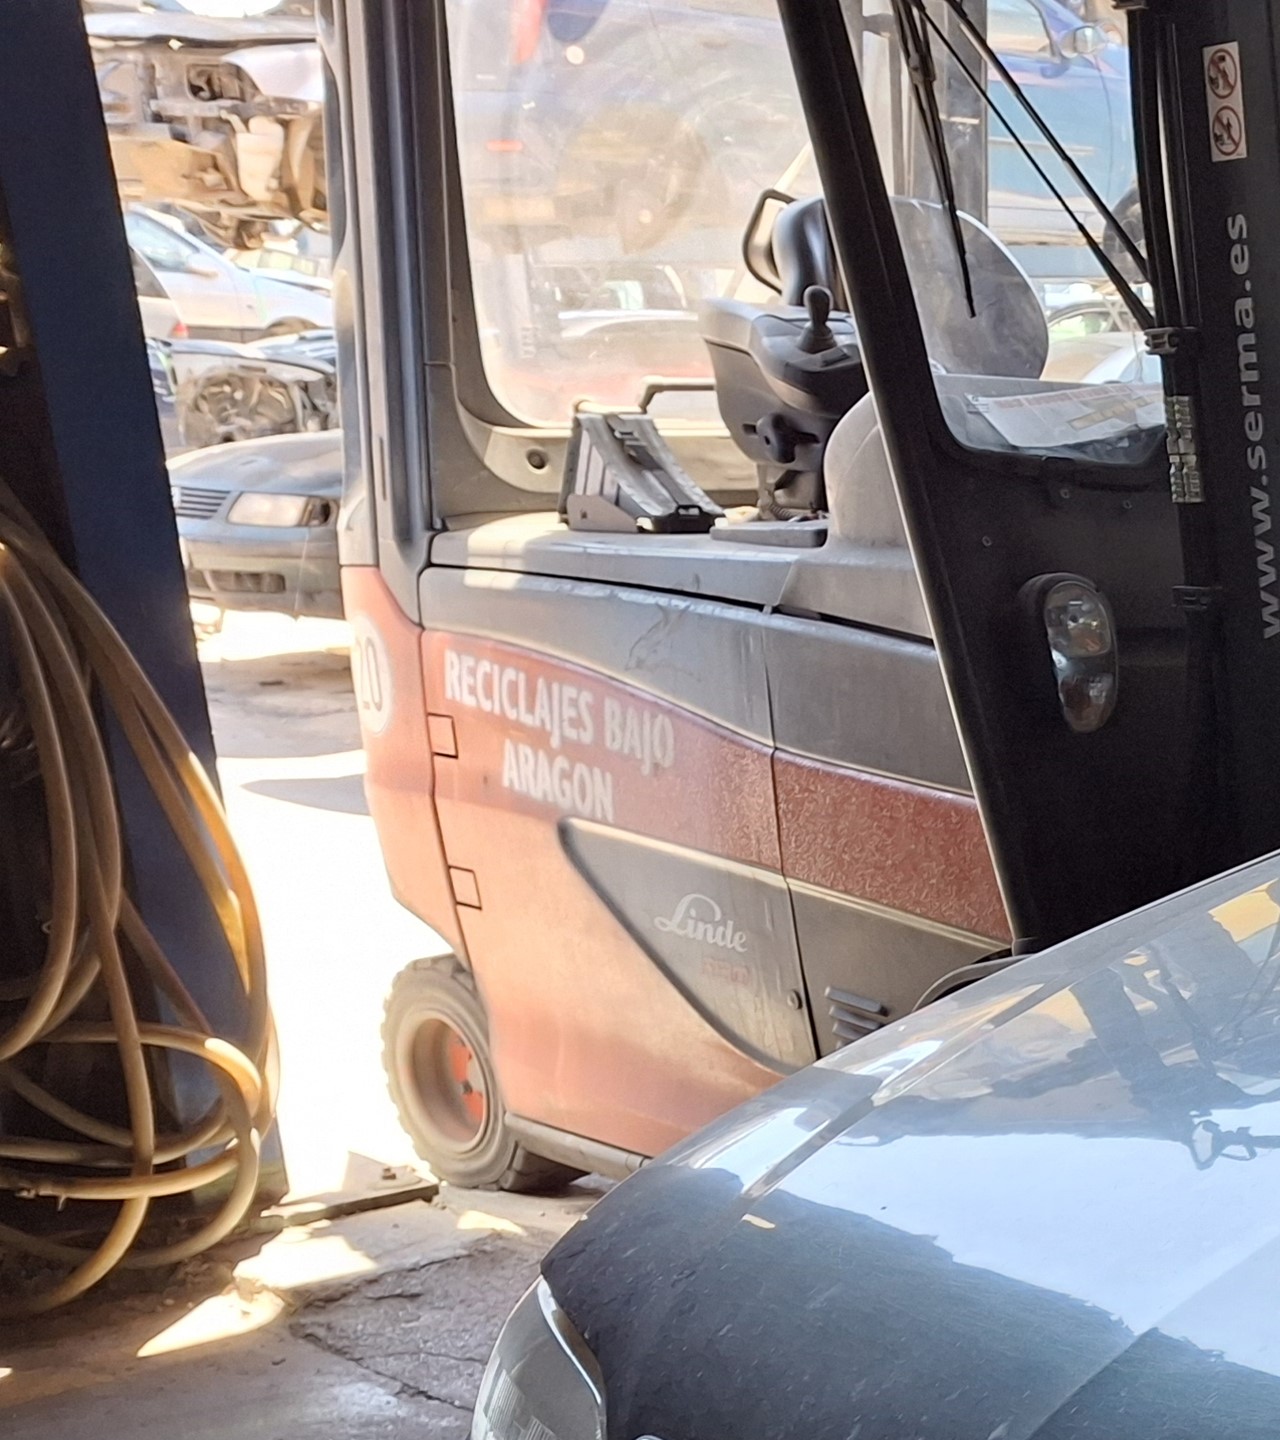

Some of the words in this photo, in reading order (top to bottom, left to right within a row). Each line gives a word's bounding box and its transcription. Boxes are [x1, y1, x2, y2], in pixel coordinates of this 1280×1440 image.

[444, 650, 594, 748] RECICLAJES
[603, 699, 675, 774] BAJO
[502, 740, 615, 822] ARAGON
[653, 893, 748, 953] Linde
